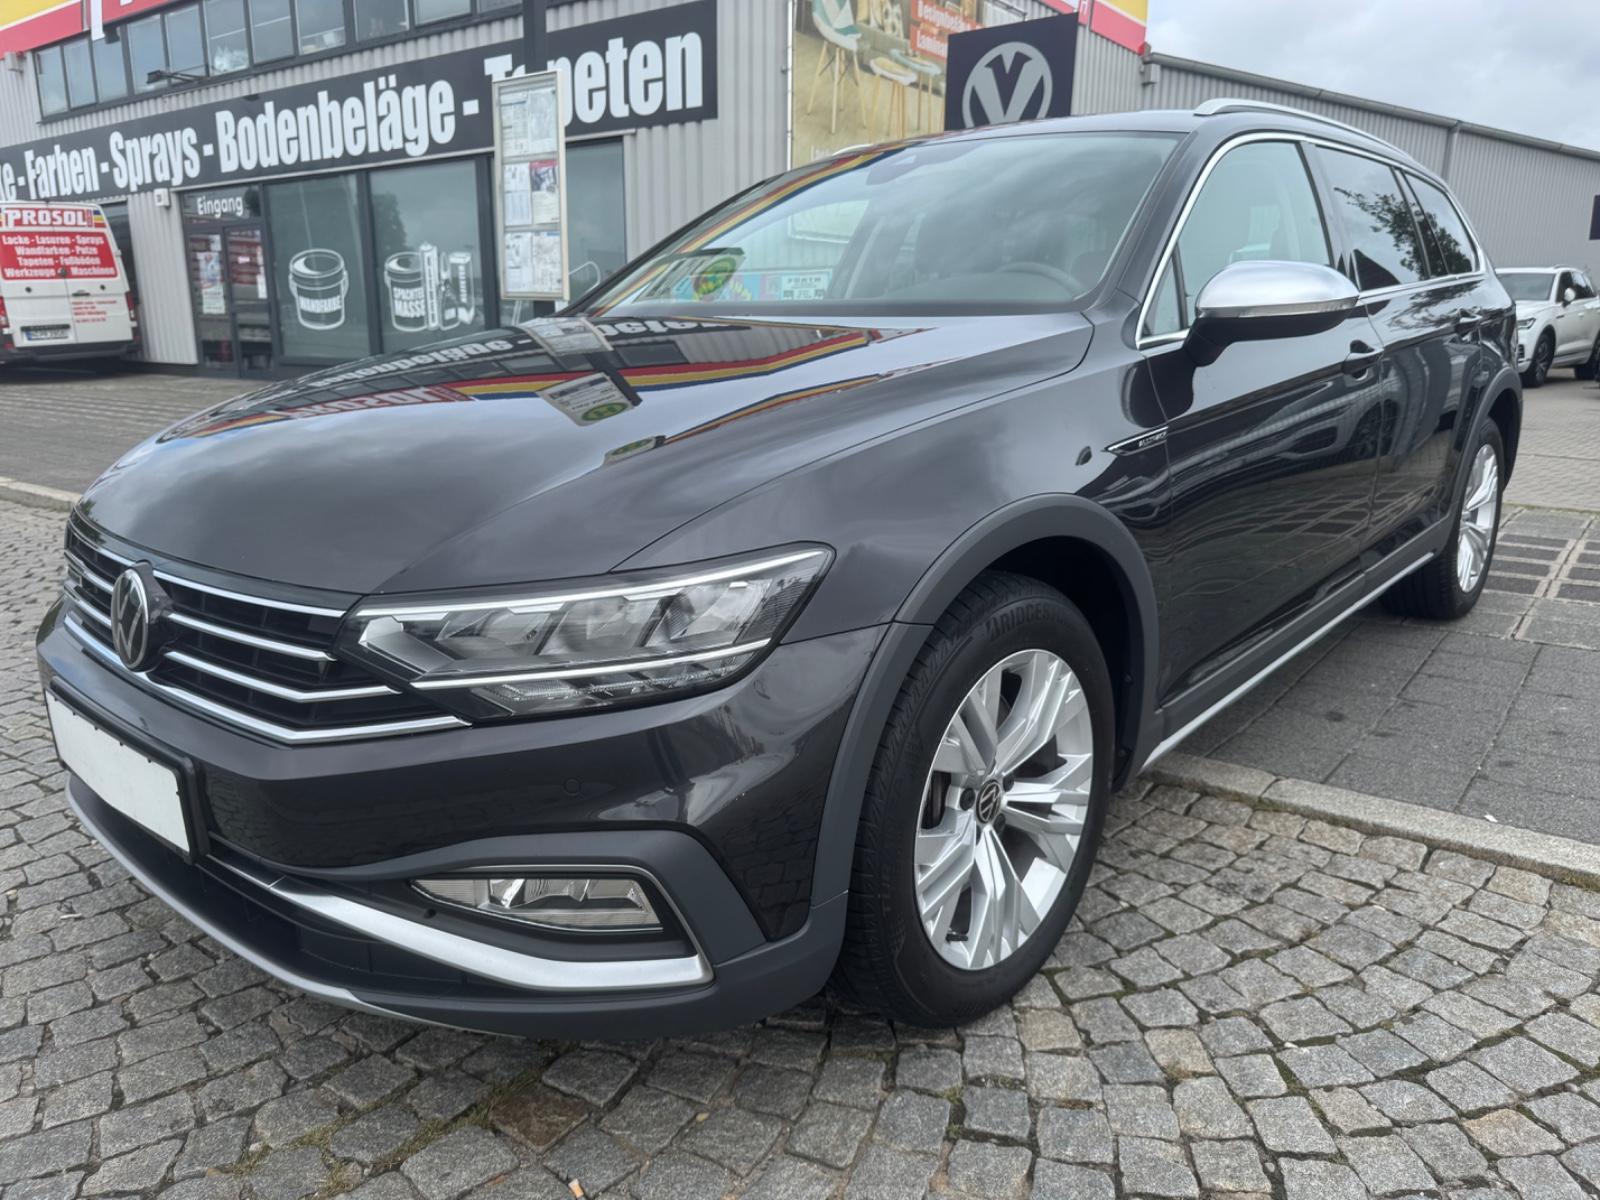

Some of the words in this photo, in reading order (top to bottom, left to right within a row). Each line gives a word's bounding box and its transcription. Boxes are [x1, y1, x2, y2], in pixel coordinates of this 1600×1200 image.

[24, 144, 99, 199] Farben
[109, 127, 200, 192] Sprays
[215, 74, 456, 173] Bodenbeläge
[197, 195, 243, 219] Eingang
[4, 209, 87, 227] PROSOL
[17, 257, 54, 266] Tapeten
